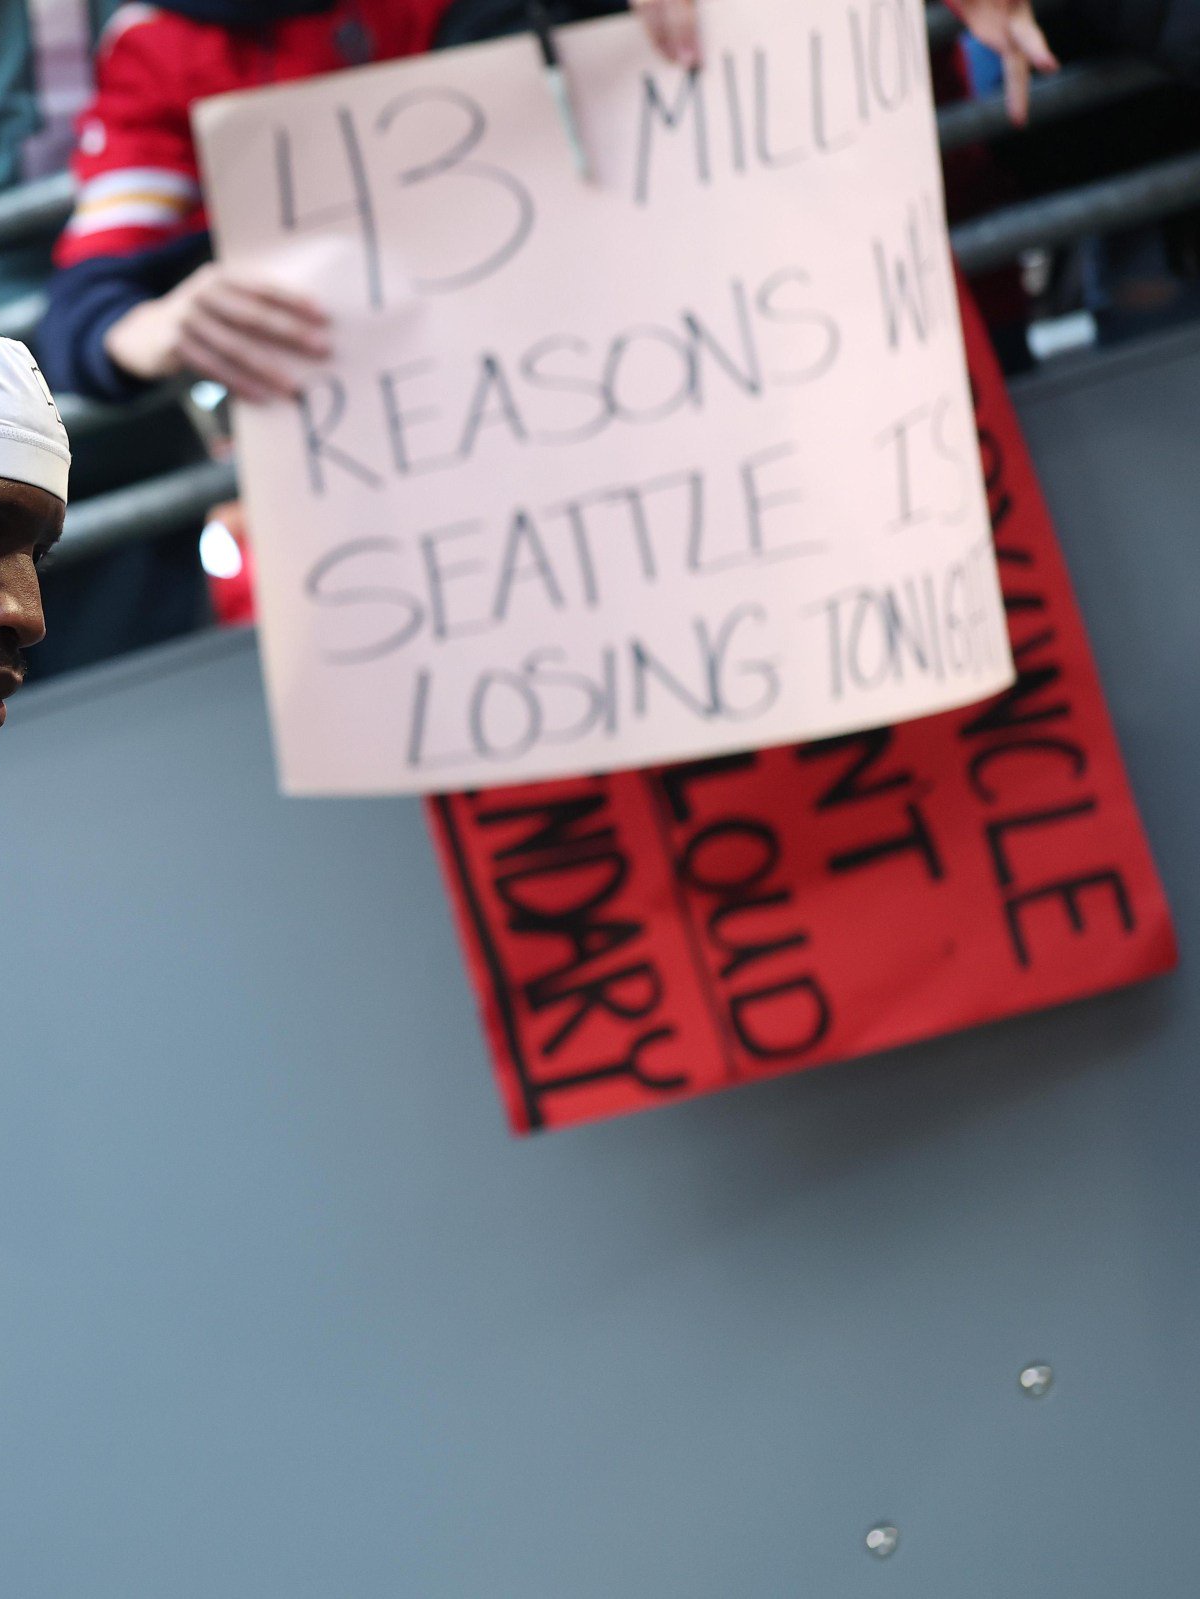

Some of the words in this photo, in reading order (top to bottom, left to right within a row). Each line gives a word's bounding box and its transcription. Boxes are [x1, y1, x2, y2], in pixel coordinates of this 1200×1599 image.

[274, 86, 536, 311] 43
[293, 266, 842, 495] REASONS
[304, 443, 828, 667] SEATTLE
[872, 393, 972, 534] IS
[403, 604, 781, 771] LOSING
[467, 776, 690, 1095] NDARY
